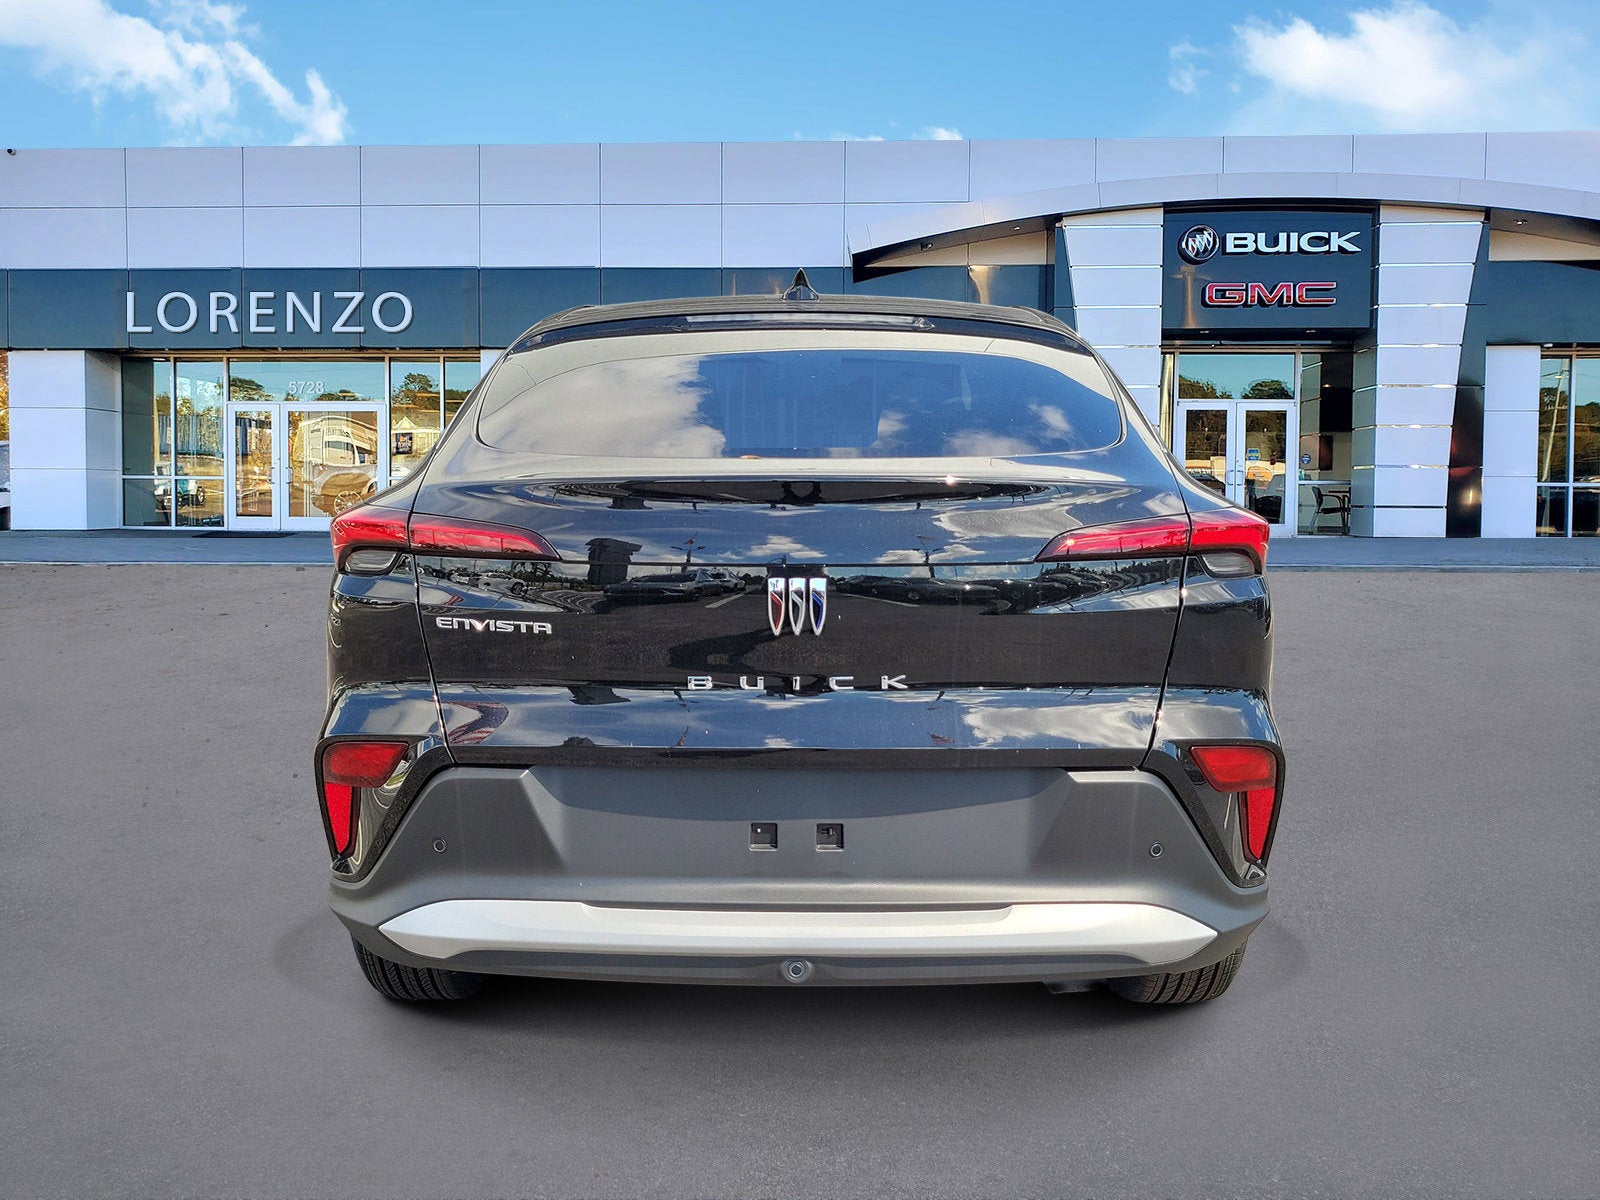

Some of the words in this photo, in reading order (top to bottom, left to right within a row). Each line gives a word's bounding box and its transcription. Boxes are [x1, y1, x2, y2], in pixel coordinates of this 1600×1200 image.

[1225, 231, 1362, 253] BUICK
[1206, 281, 1337, 305] GMC
[126, 290, 414, 334] LORENZO
[288, 380, 325, 395] 5728
[435, 616, 553, 635] ENVISTA
[687, 674, 909, 691] BUICK
